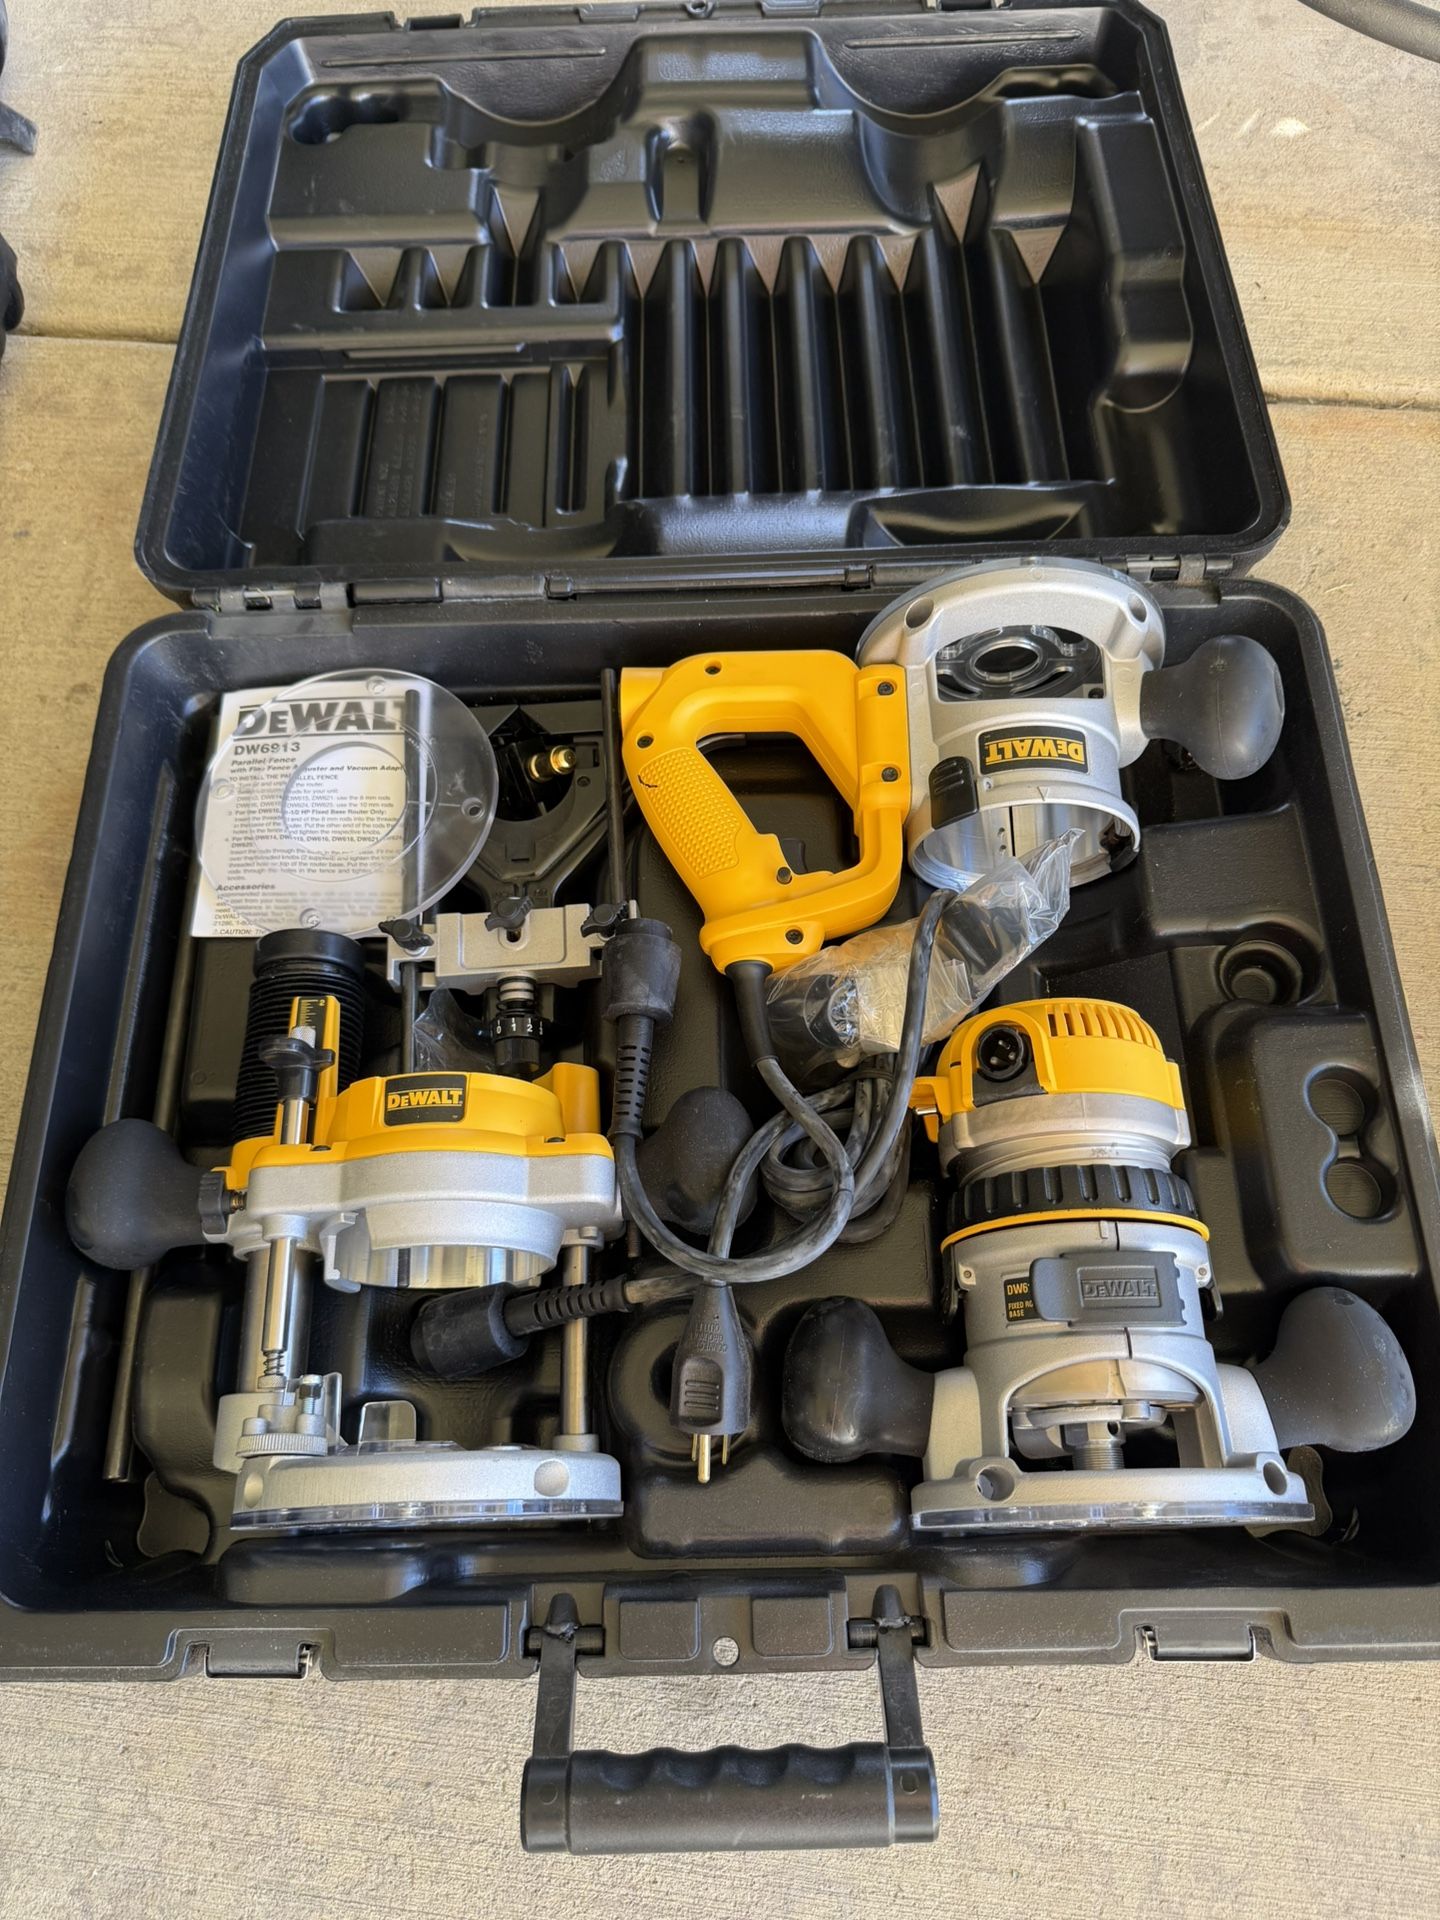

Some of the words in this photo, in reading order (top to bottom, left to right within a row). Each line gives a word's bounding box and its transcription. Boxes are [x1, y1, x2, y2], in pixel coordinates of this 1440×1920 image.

[985, 738, 1085, 762] DEWALT
[380, 764, 403, 773] Adapt
[216, 883, 276, 891] Accessories
[527, 1023, 533, 1033] 2
[387, 1090, 463, 1109] DEWALT
[1007, 1282, 1030, 1296] DW6
[1083, 1278, 1157, 1298] DEWALT
[1008, 1301, 1024, 1310] FIXED
[1009, 1309, 1025, 1318] BASE
